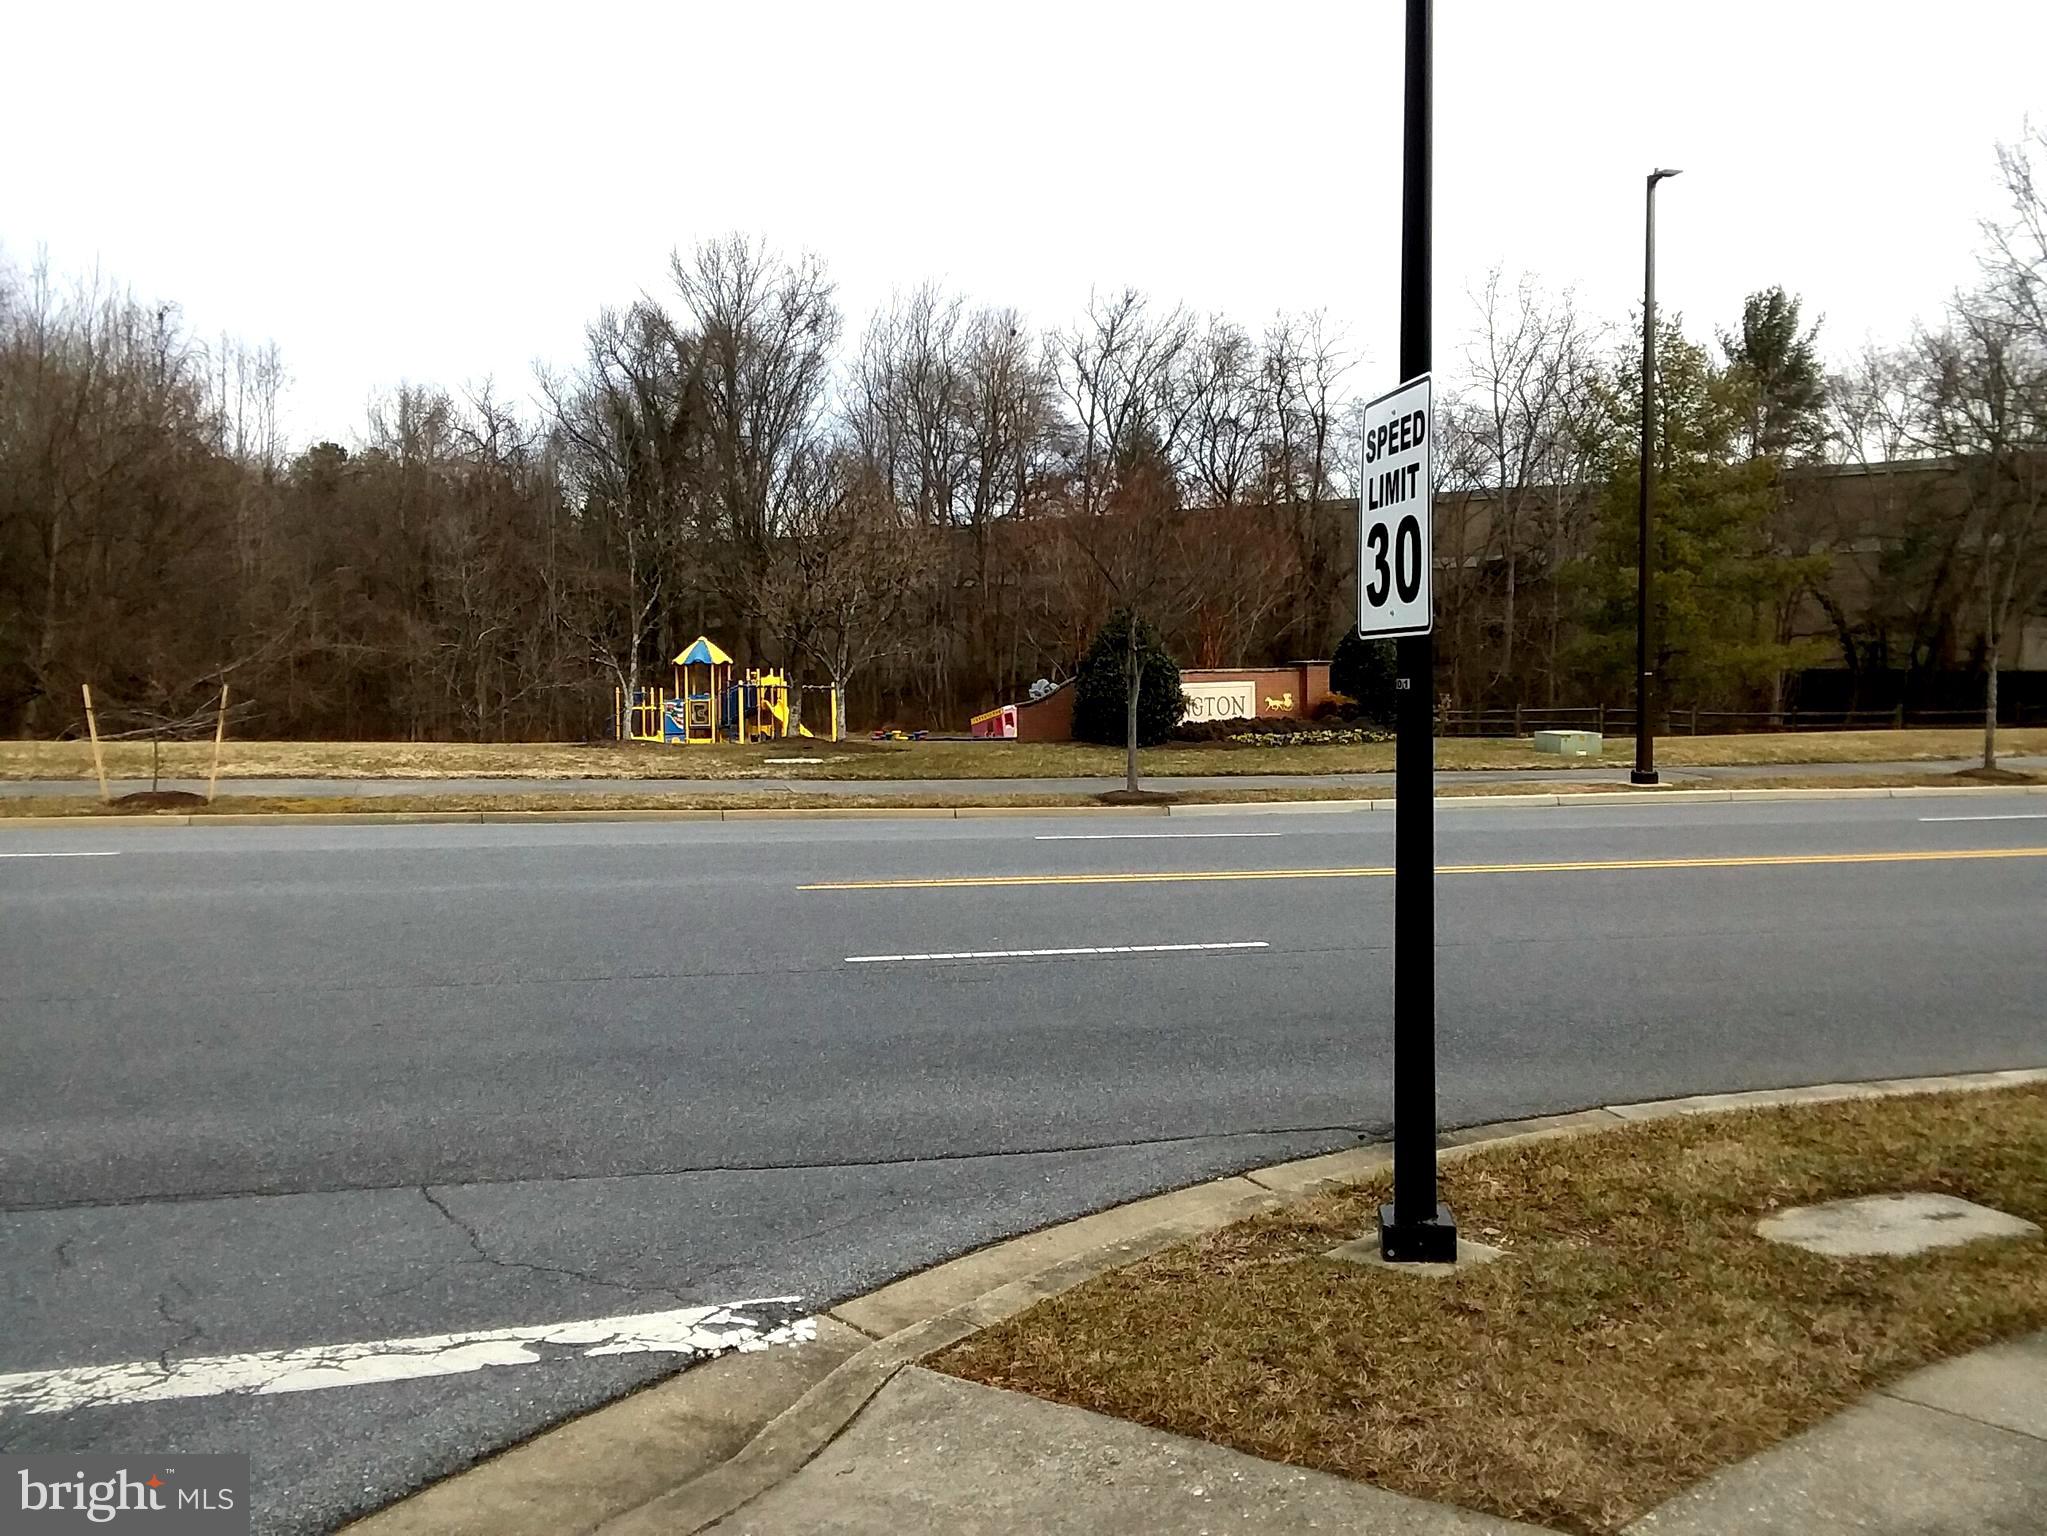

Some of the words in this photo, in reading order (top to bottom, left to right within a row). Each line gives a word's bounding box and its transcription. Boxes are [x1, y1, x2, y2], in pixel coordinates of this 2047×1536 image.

[1366, 410, 1425, 464] SPEED
[1369, 462, 1420, 510] LIMIT
[1366, 515, 1422, 608] 30
